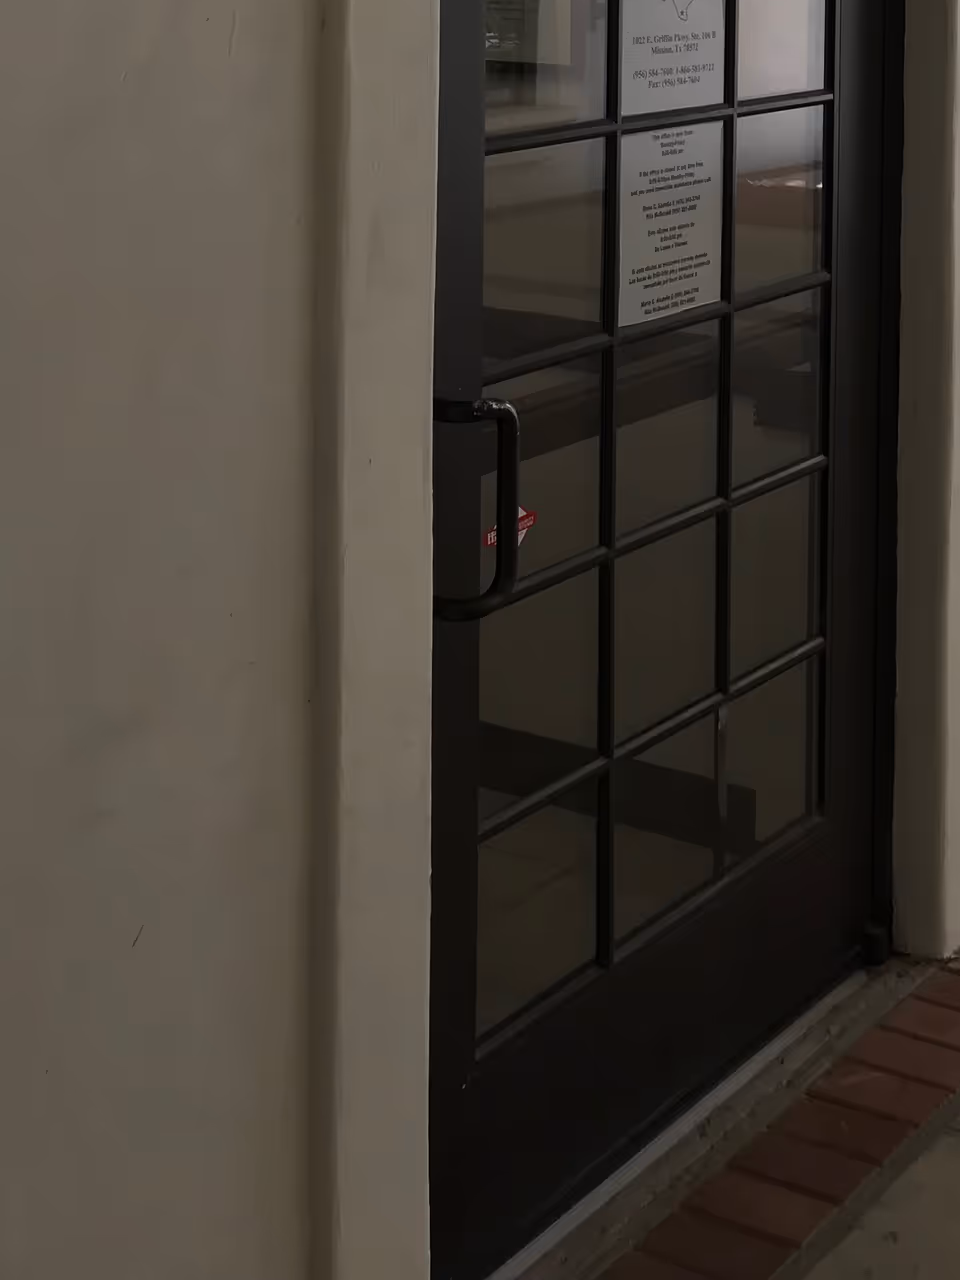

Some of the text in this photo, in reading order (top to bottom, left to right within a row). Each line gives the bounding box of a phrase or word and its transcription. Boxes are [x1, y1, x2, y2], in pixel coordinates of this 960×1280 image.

[632, 70, 647, 80] (956)
[648, 80, 661, 89] Fax:
[662, 78, 676, 88] (956)
